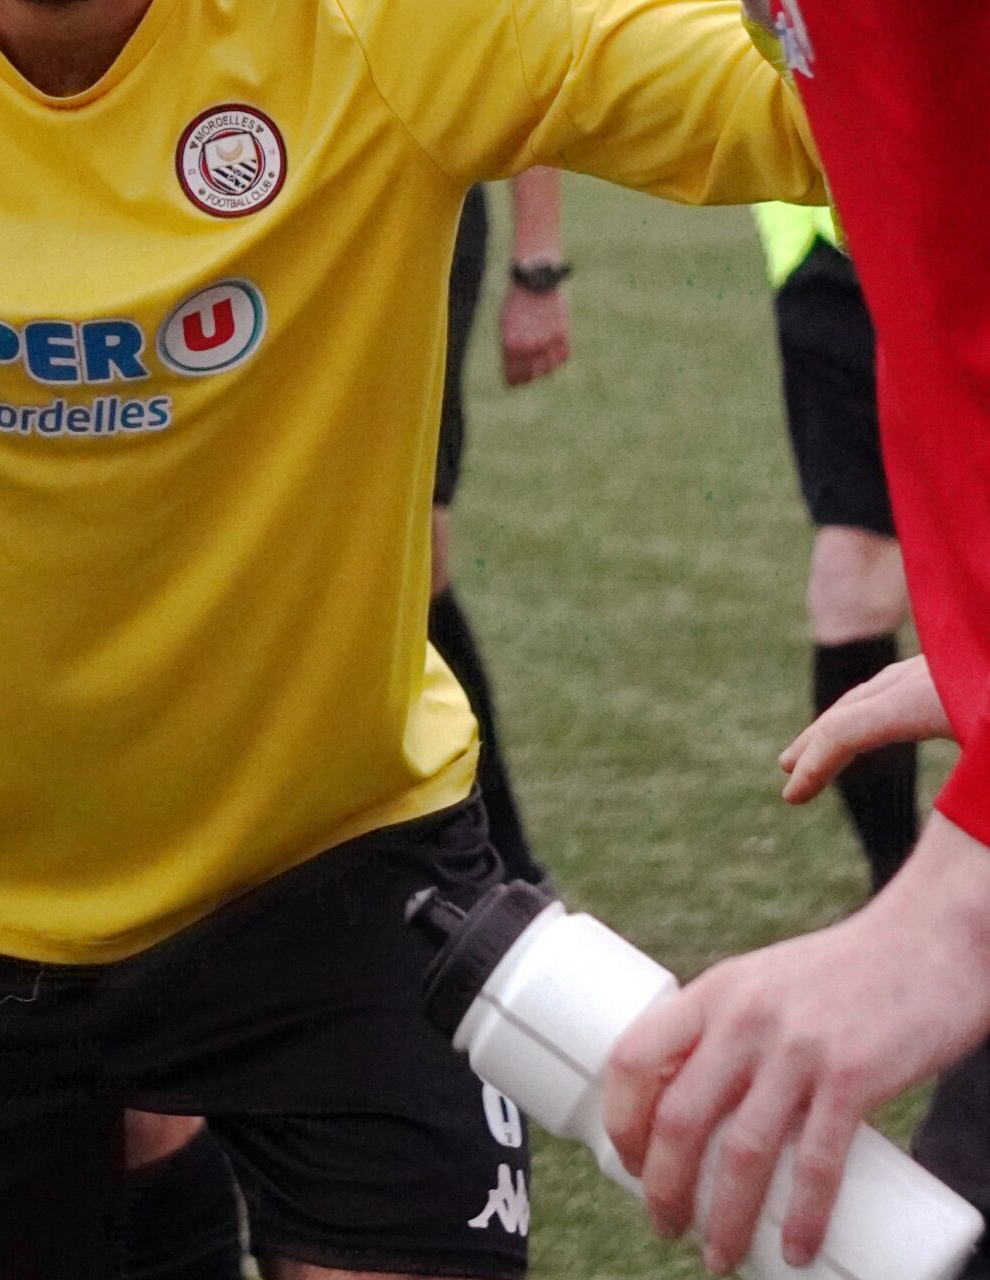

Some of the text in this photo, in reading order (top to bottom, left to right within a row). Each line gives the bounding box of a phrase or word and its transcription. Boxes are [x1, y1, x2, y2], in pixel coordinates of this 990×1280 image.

[195, 115, 255, 142] MORDELLES
[206, 180, 272, 208] FOOTBALL CLUB
[182, 297, 235, 352] U
